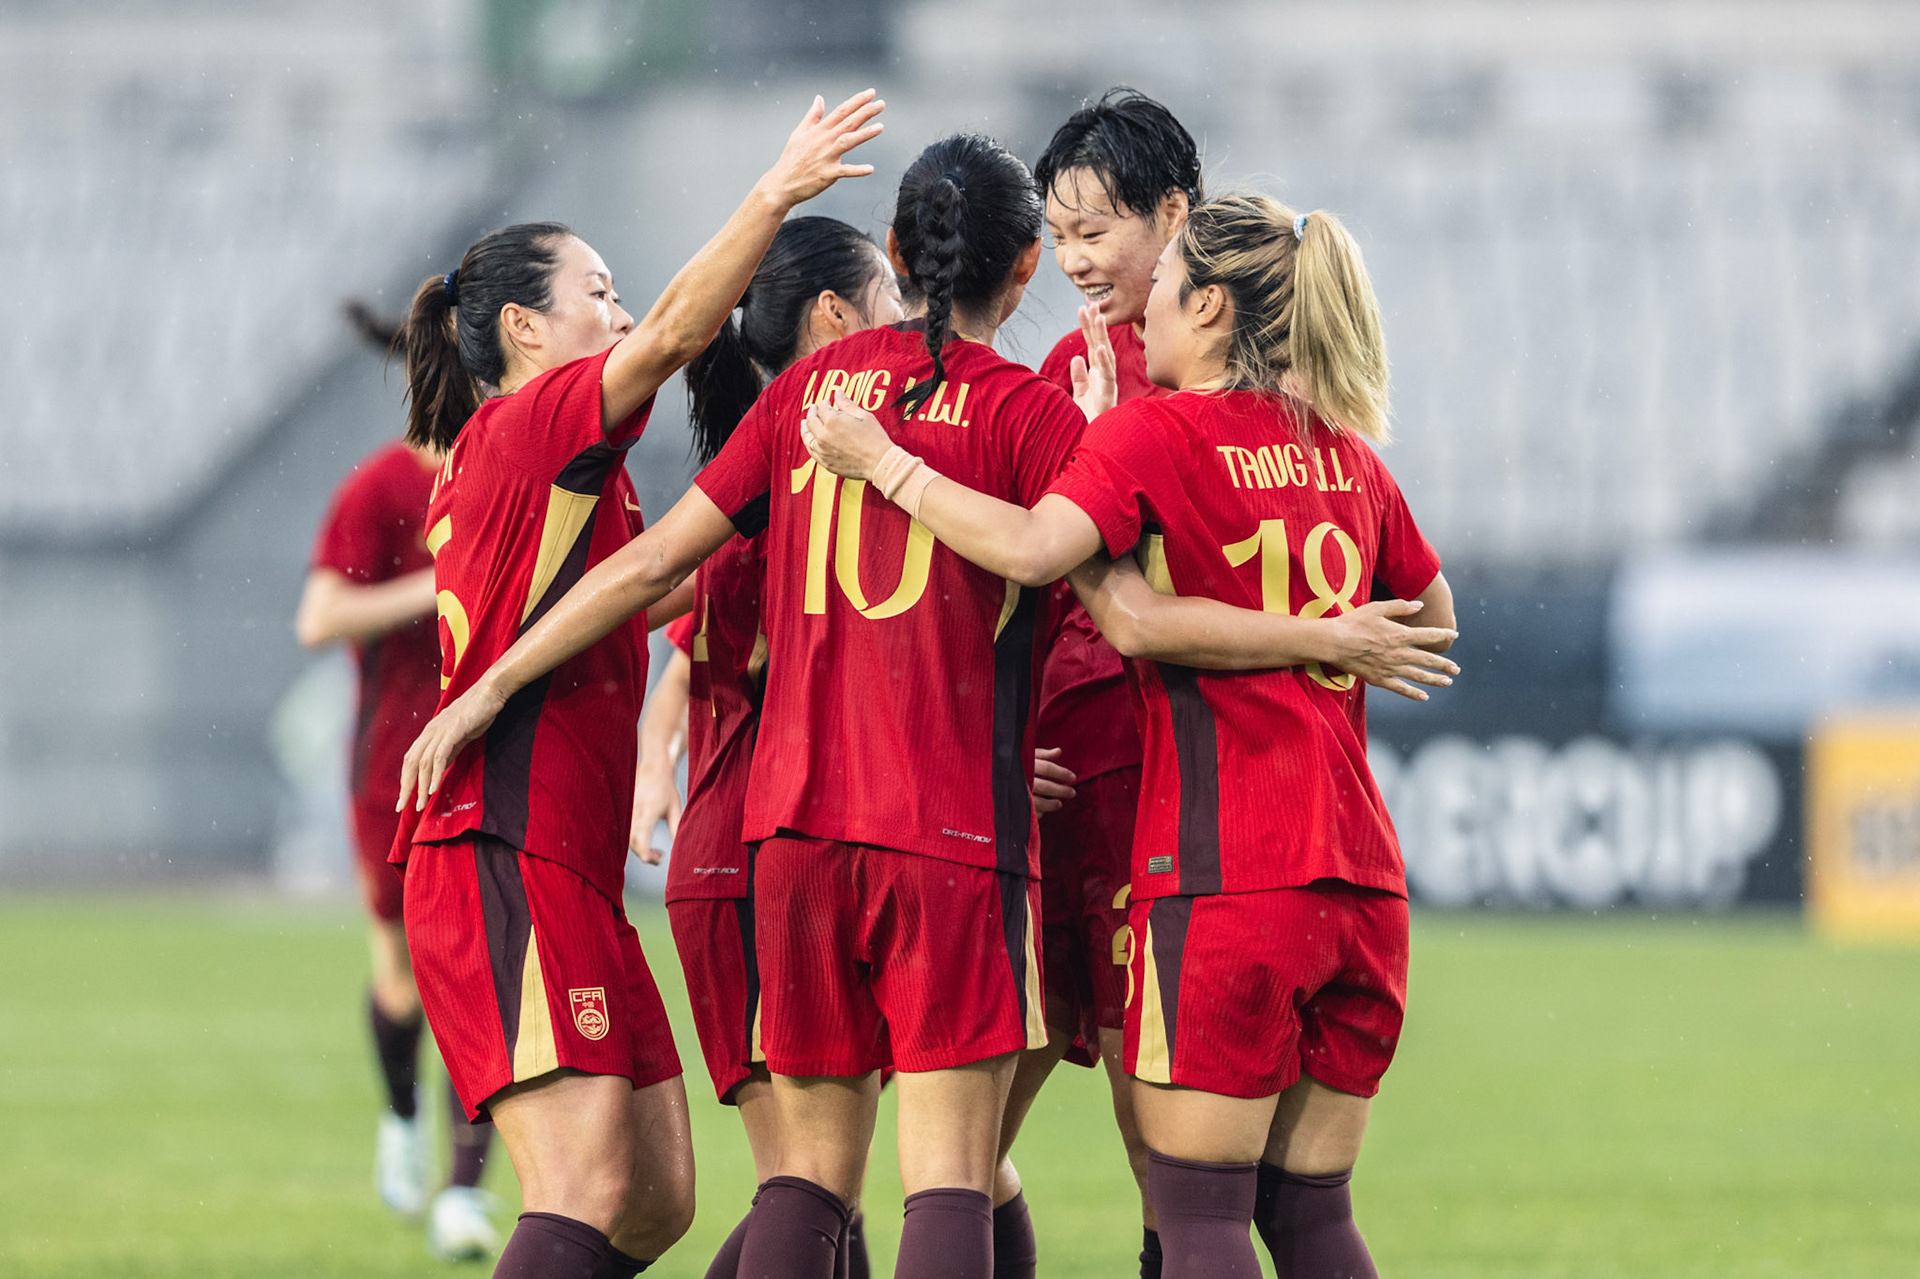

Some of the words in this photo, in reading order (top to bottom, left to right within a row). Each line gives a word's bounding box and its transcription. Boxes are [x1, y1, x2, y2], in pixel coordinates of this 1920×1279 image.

[802, 369, 891, 411] WANG
[1216, 443, 1308, 489] TANG
[1314, 447, 1362, 493] J.L.
[791, 457, 935, 620] 10
[1222, 519, 1362, 691] 18
[572, 990, 603, 1003] CFA
